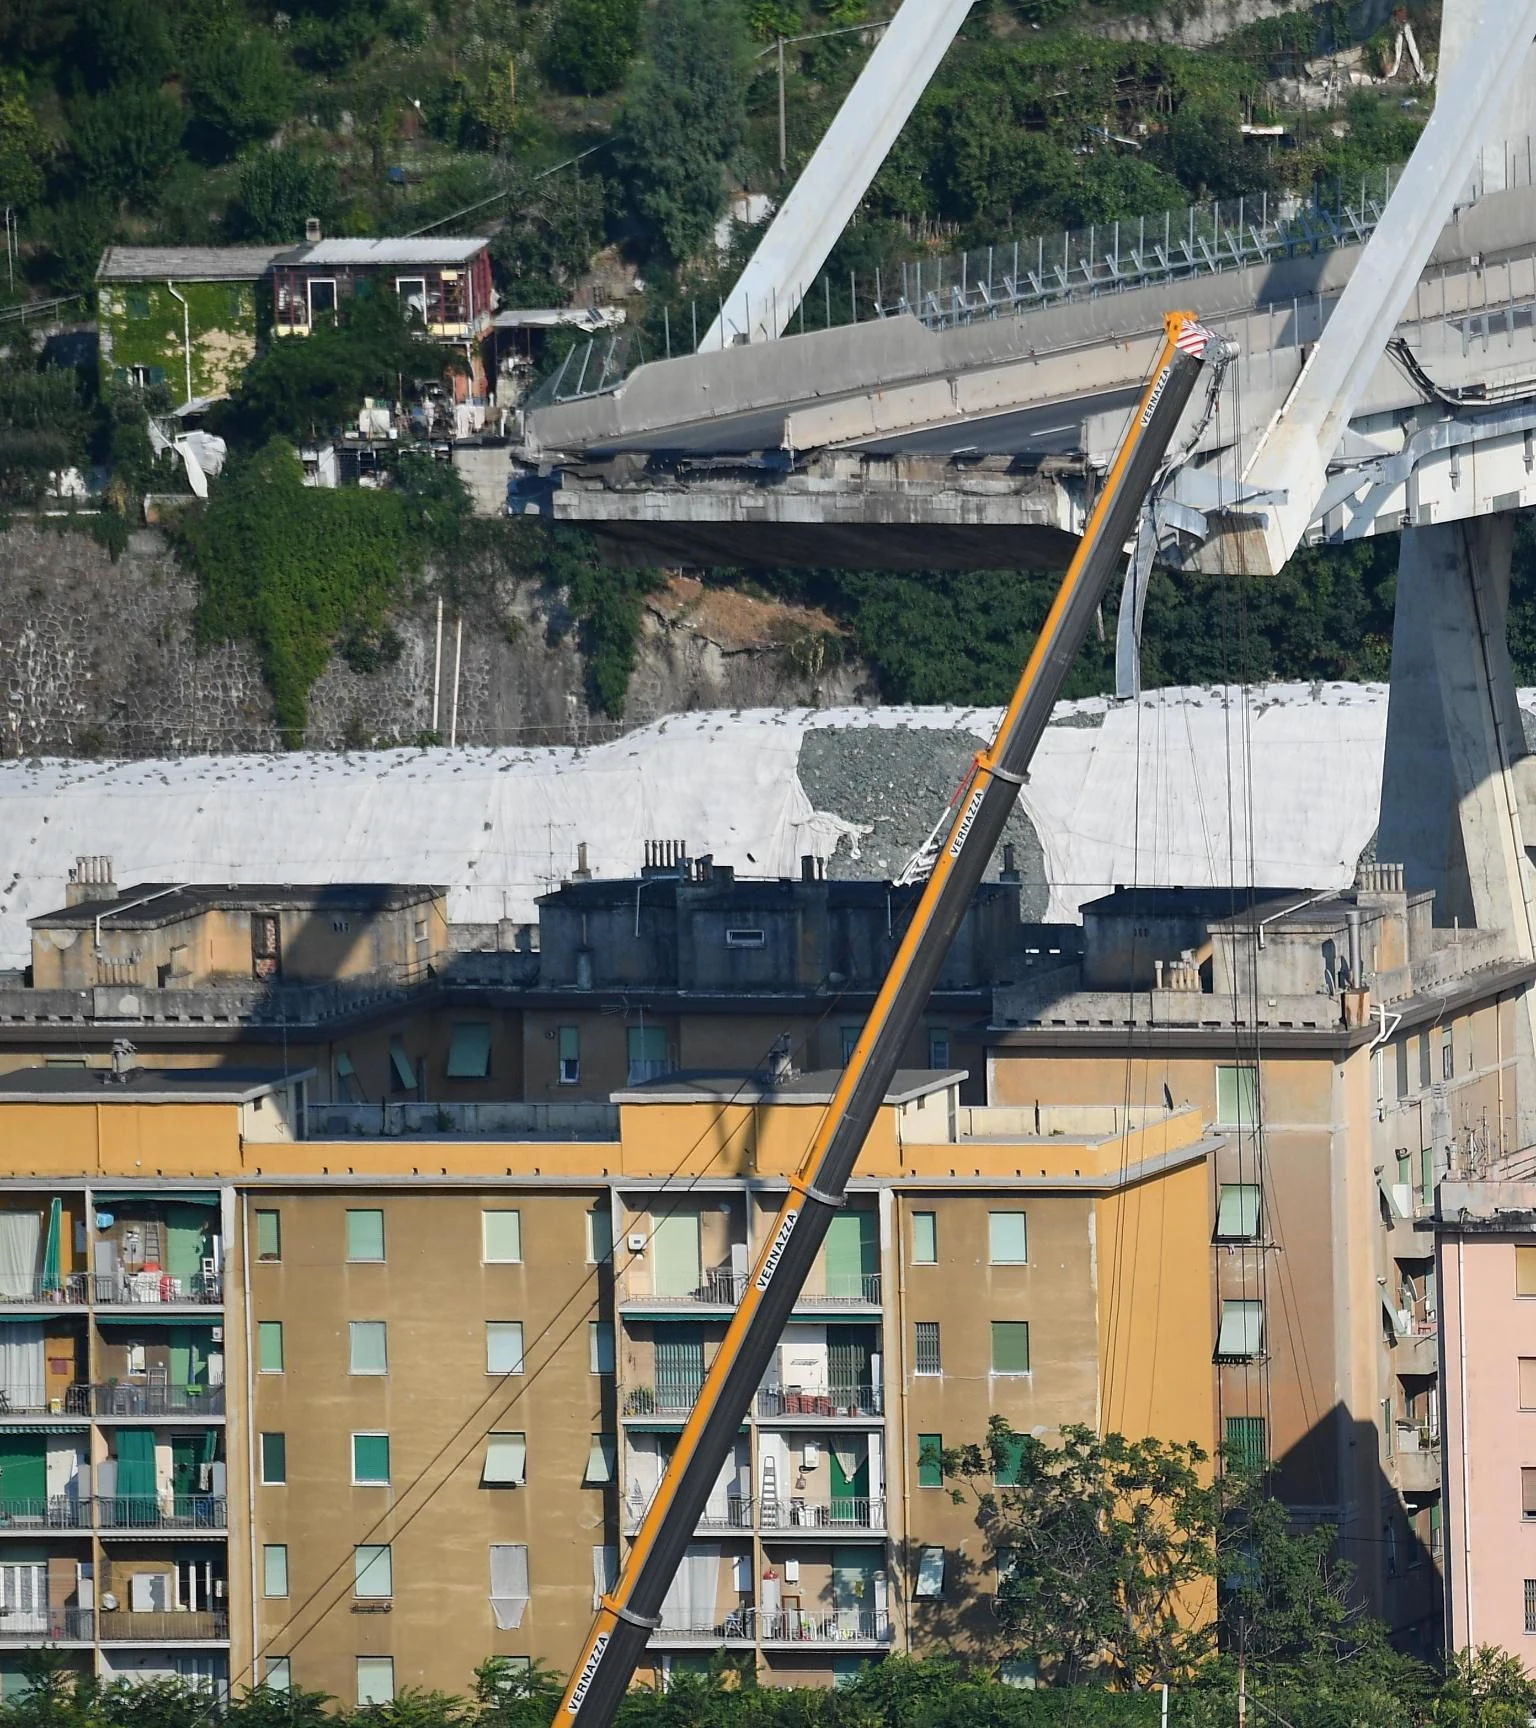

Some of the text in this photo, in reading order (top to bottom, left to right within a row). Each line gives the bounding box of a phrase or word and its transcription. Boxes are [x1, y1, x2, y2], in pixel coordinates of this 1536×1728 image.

[1141, 368, 1171, 425] VERNAZZA
[950, 791, 984, 854] VERNAZZA
[757, 1213, 797, 1288] VERNAZZA
[568, 1635, 609, 1710] VERNAZZA
